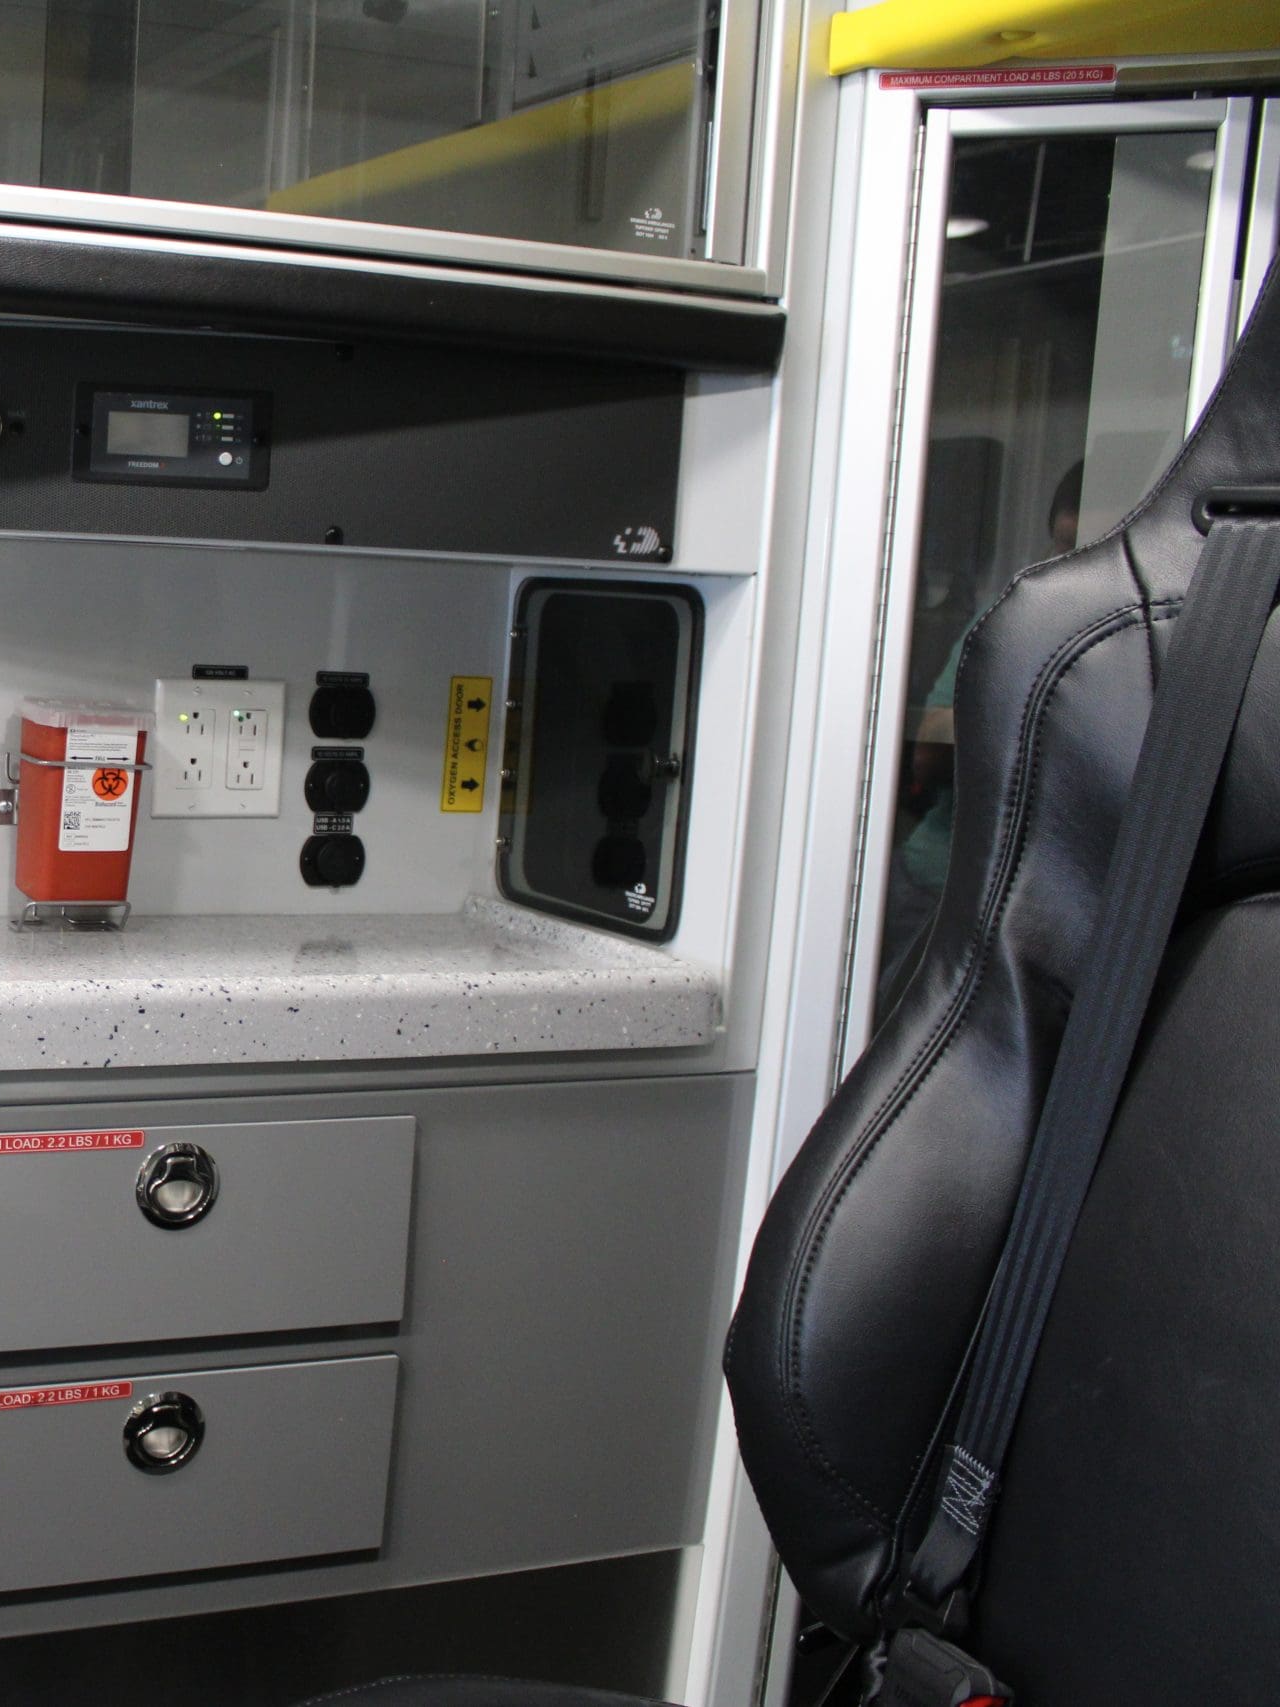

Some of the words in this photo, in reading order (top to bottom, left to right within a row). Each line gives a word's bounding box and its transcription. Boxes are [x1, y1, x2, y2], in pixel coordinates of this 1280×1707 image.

[890, 75, 933, 86] MAXIMUM
[934, 72, 1004, 84] COMPARTMENT
[1004, 72, 1029, 82] LOAD
[1030, 72, 1041, 81] 45
[1043, 70, 1061, 81] LBS
[1086, 69, 1104, 79] KG)
[130, 400, 169, 410] xantrex
[455, 684, 464, 714] DOOR
[452, 718, 462, 759] ACCESS
[448, 762, 458, 805] OXYGEN
[5, 1138, 44, 1150] LOAD:
[47, 1137, 65, 1148] 2.2
[68, 1135, 93, 1147] LBS
[95, 1135, 101, 1146] /
[104, 1135, 109, 1145] 1
[113, 1134, 132, 1145] KG
[58, 1389, 82, 1401] LBS
[84, 1387, 90, 1399] /
[93, 1387, 98, 1398] 1
[102, 1385, 120, 1397] KG
